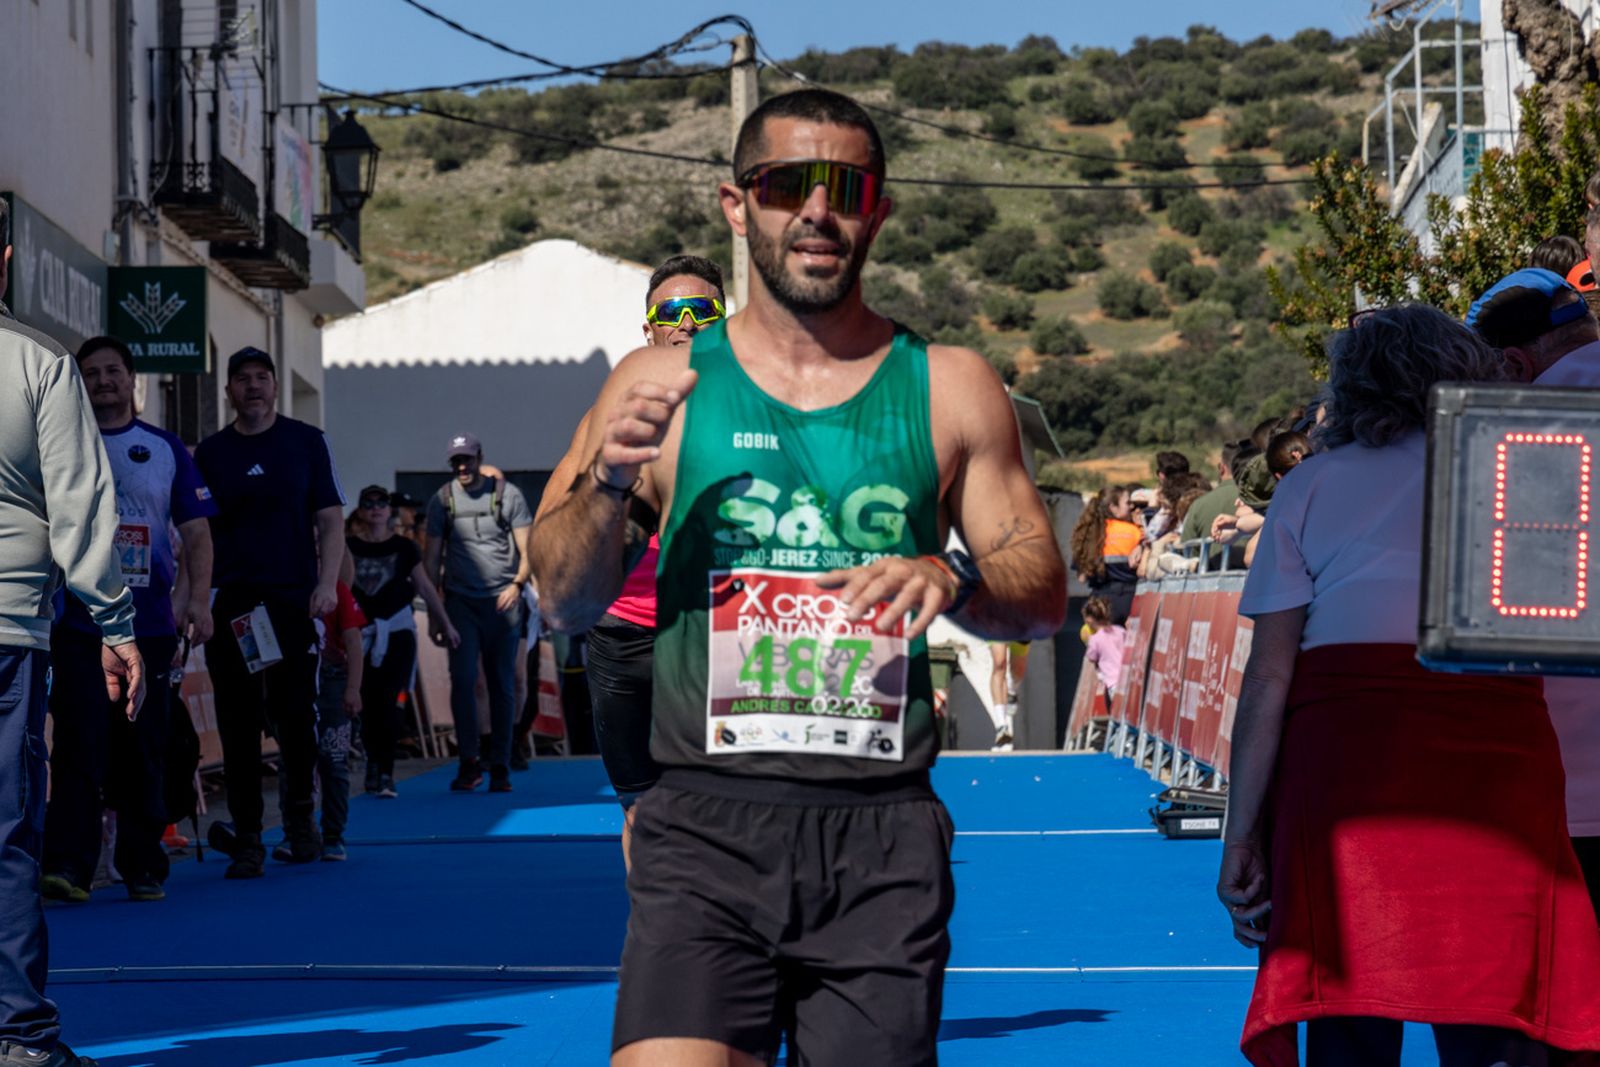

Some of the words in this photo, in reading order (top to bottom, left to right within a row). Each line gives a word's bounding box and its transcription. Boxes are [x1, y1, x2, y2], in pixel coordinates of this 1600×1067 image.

[147, 342, 200, 357] RURAL
[732, 432, 780, 450] GOBIK
[713, 478, 910, 550] S&G
[861, 552, 903, 566] 20
[738, 580, 769, 614] X
[737, 615, 851, 641] PANTANO
[738, 635, 873, 698] 487
[731, 699, 790, 714] ANDRES
